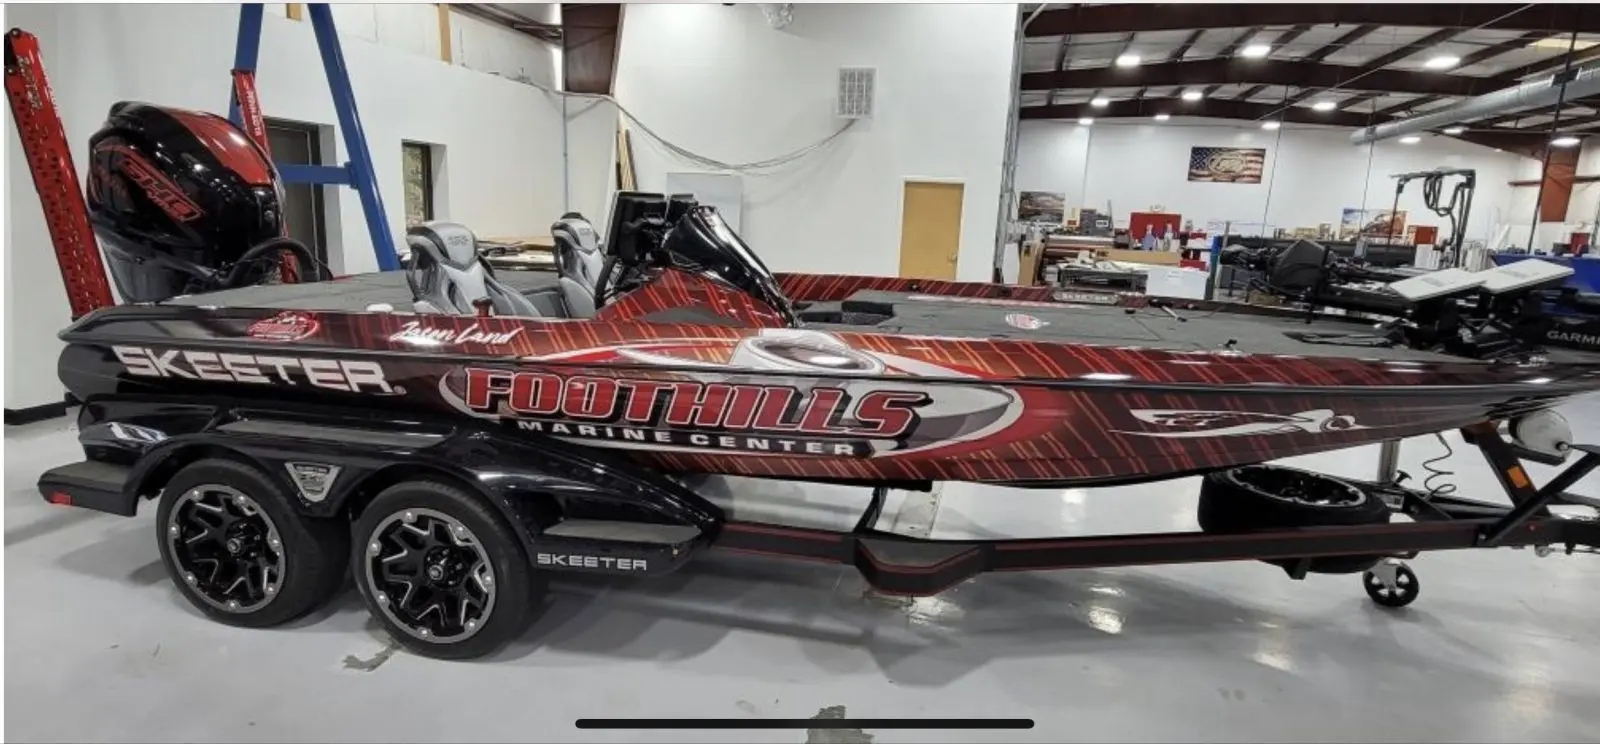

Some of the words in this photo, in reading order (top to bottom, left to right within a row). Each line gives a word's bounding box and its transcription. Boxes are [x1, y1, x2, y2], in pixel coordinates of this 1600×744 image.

[455, 323, 524, 344] Land
[112, 345, 394, 394] SKEETER
[465, 367, 928, 438] FOOTHILLS
[518, 420, 672, 443] MARINE
[689, 433, 855, 456] CENTER
[537, 552, 647, 571] SKEETER
